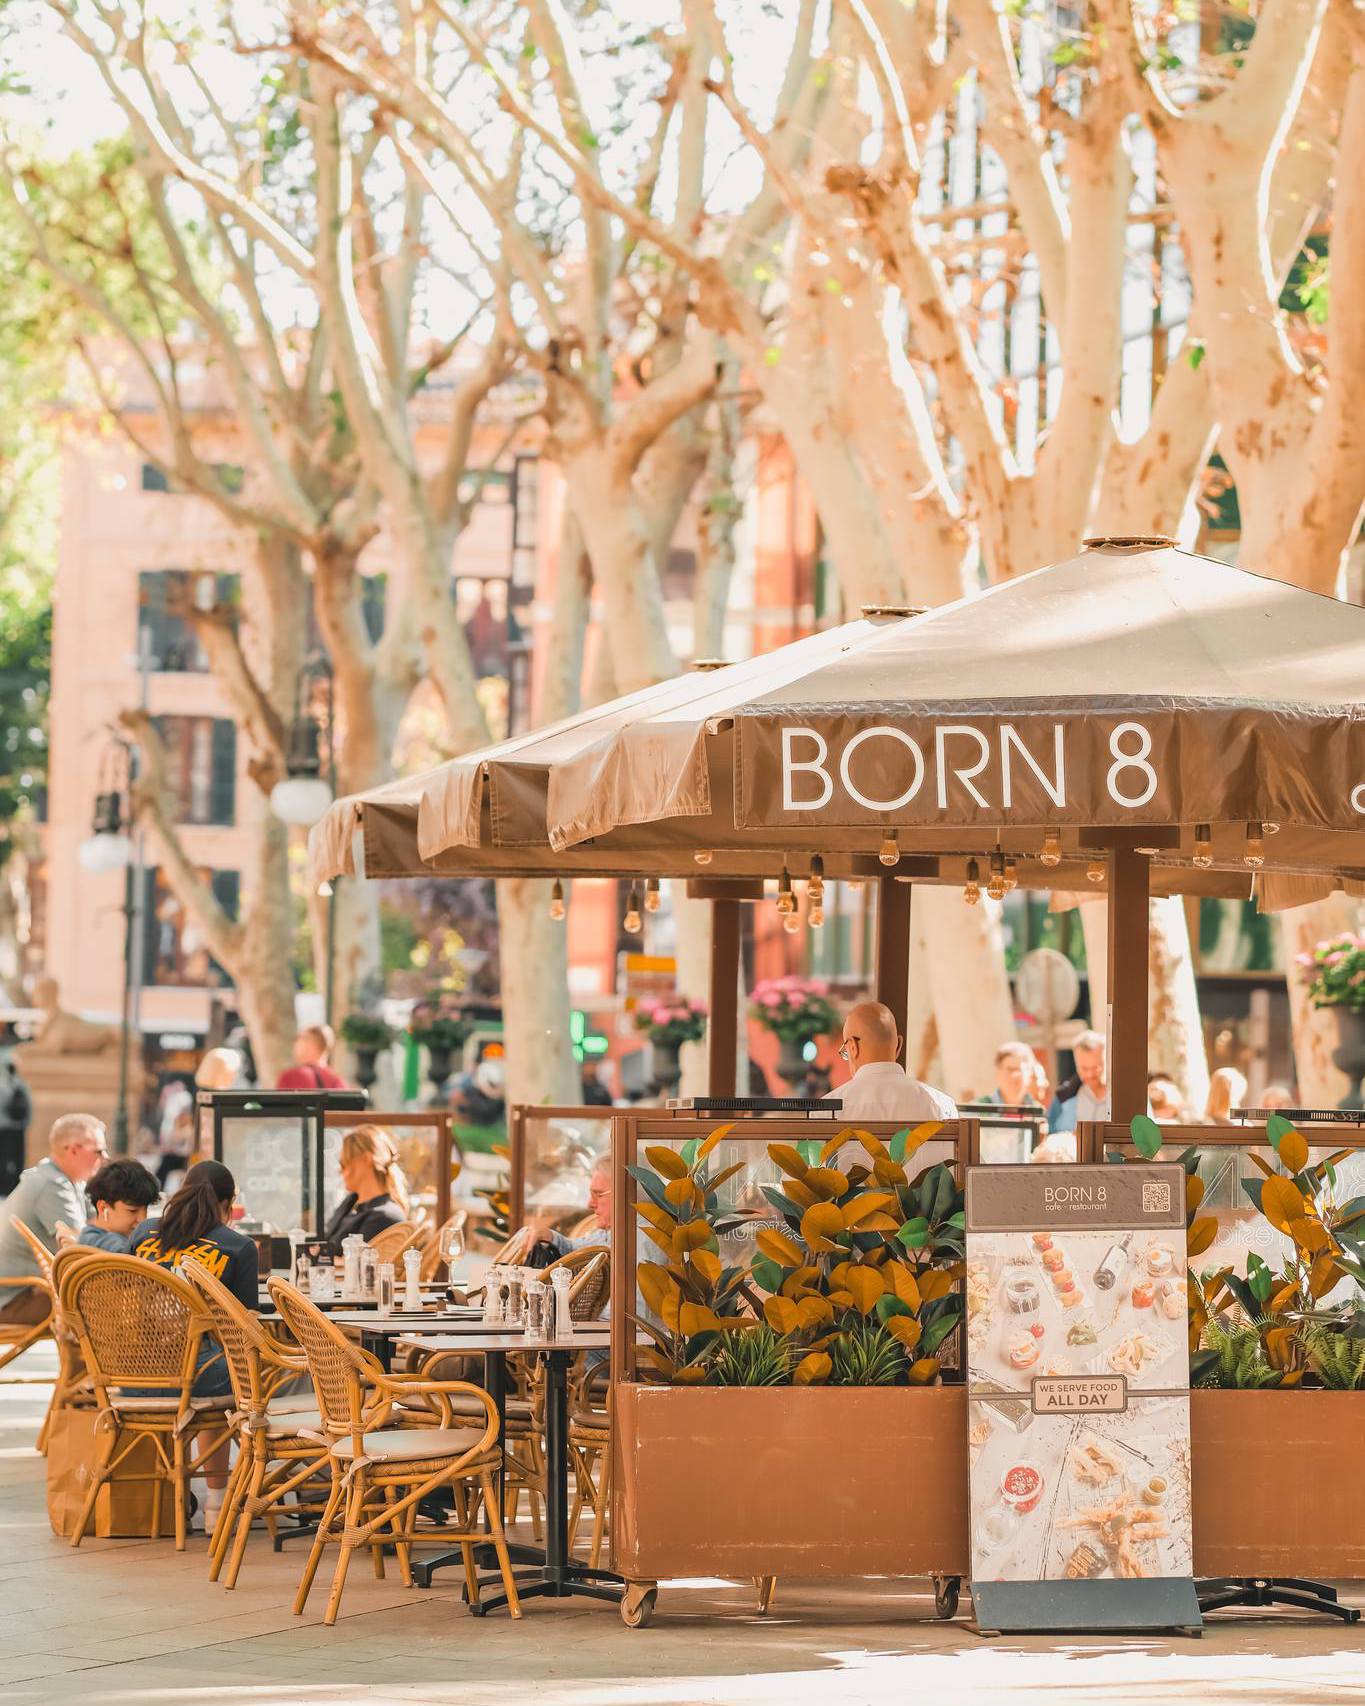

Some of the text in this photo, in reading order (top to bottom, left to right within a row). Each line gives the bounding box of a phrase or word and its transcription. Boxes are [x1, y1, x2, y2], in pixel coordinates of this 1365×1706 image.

[781, 721, 1159, 812] BORN 8
[1045, 1186, 1107, 1201] BORN 8
[1045, 1202, 1061, 1210] cafe
[1040, 1383, 1117, 1392] WE SERVE FOOD
[1047, 1394, 1108, 1406] ALL DAY
